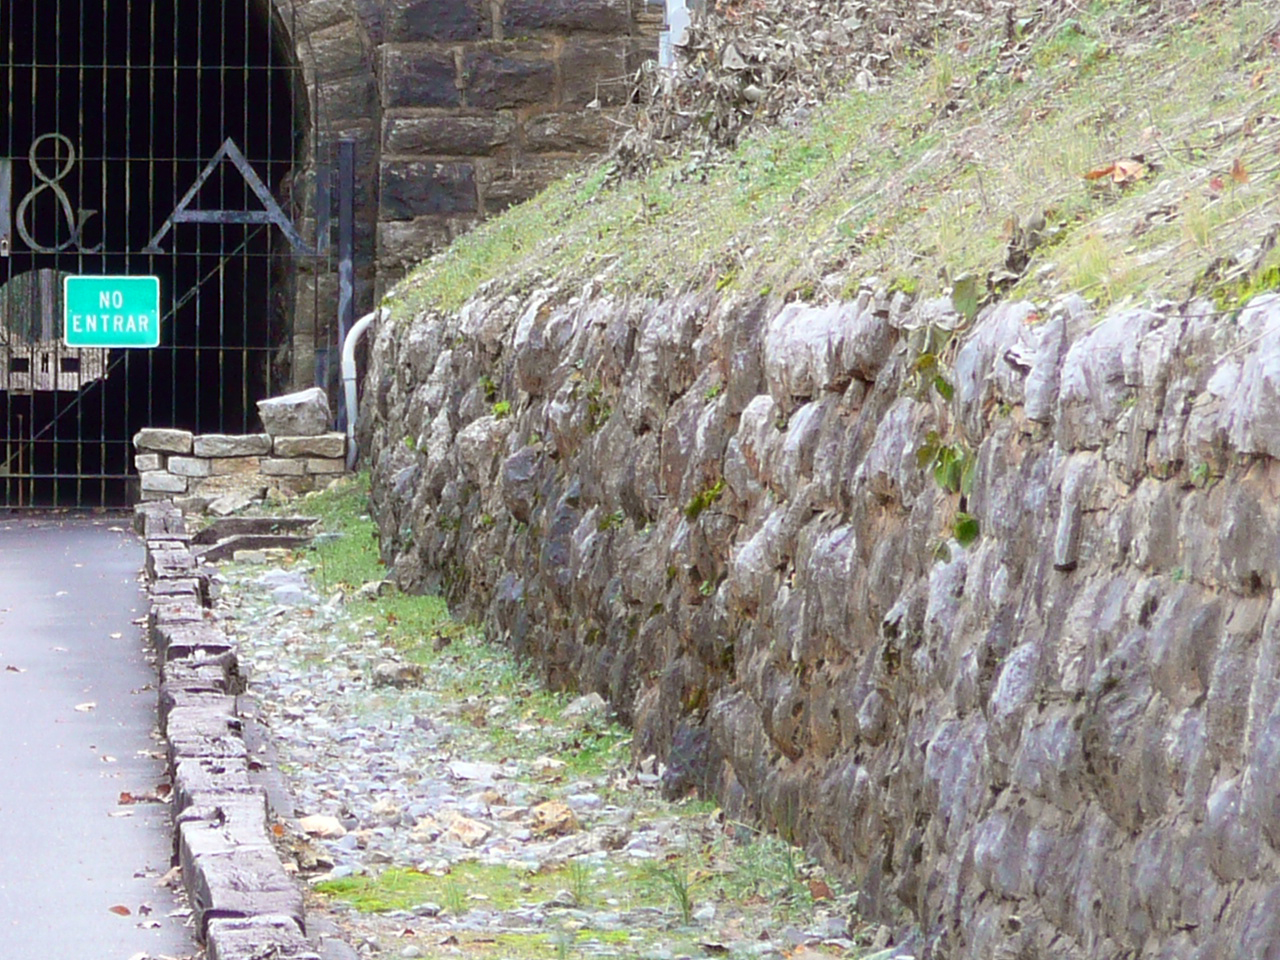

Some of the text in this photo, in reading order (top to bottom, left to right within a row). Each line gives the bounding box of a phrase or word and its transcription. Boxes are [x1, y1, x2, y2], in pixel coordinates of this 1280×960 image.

[141, 136, 317, 254] A
[98, 290, 124, 309] NO
[72, 314, 150, 333] ENTRAR
